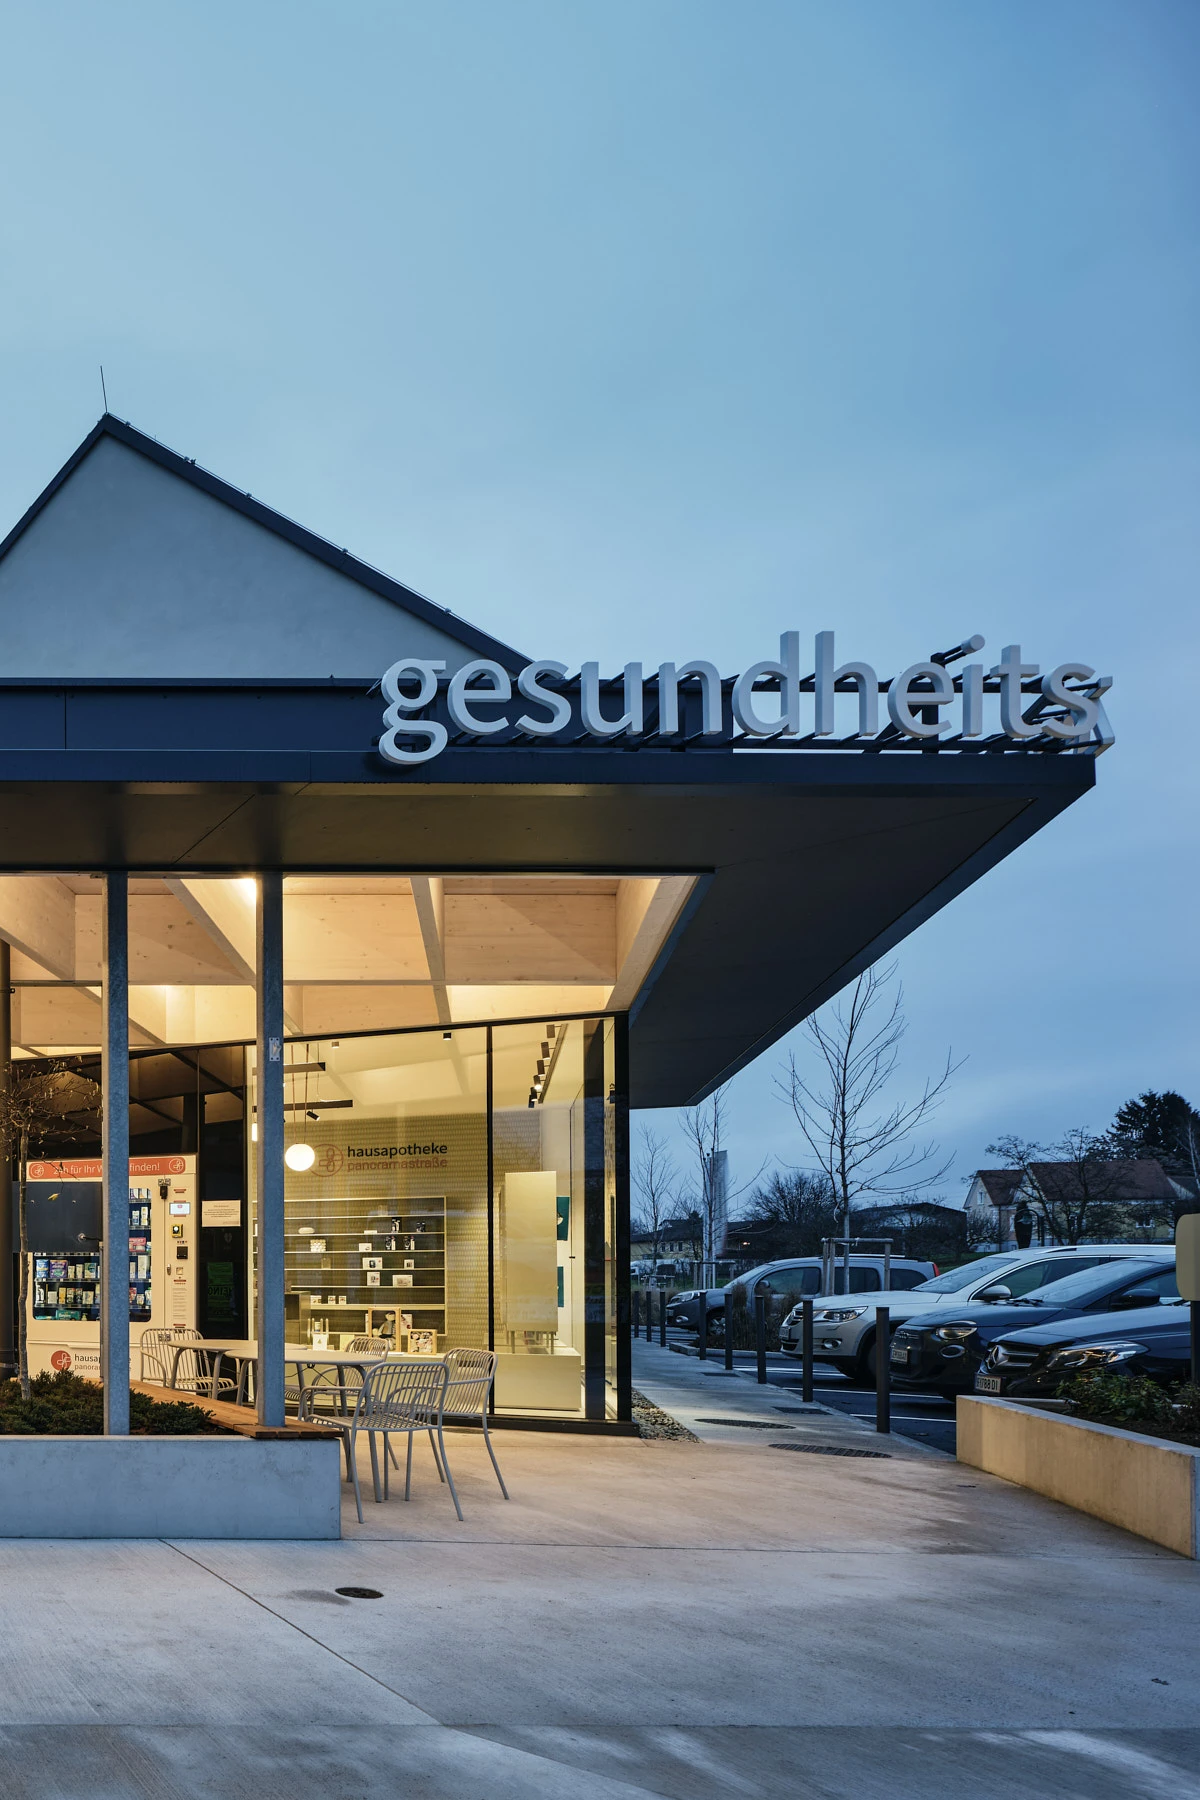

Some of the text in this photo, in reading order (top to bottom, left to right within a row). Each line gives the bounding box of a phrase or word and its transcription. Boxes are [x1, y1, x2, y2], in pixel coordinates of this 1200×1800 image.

[378, 630, 1099, 766] gesundheits
[347, 1142, 448, 1159] hausapotheke
[70, 1164, 82, 1174] für
[84, 1164, 96, 1174] Ihr
[347, 1157, 448, 1172] panoramastraße
